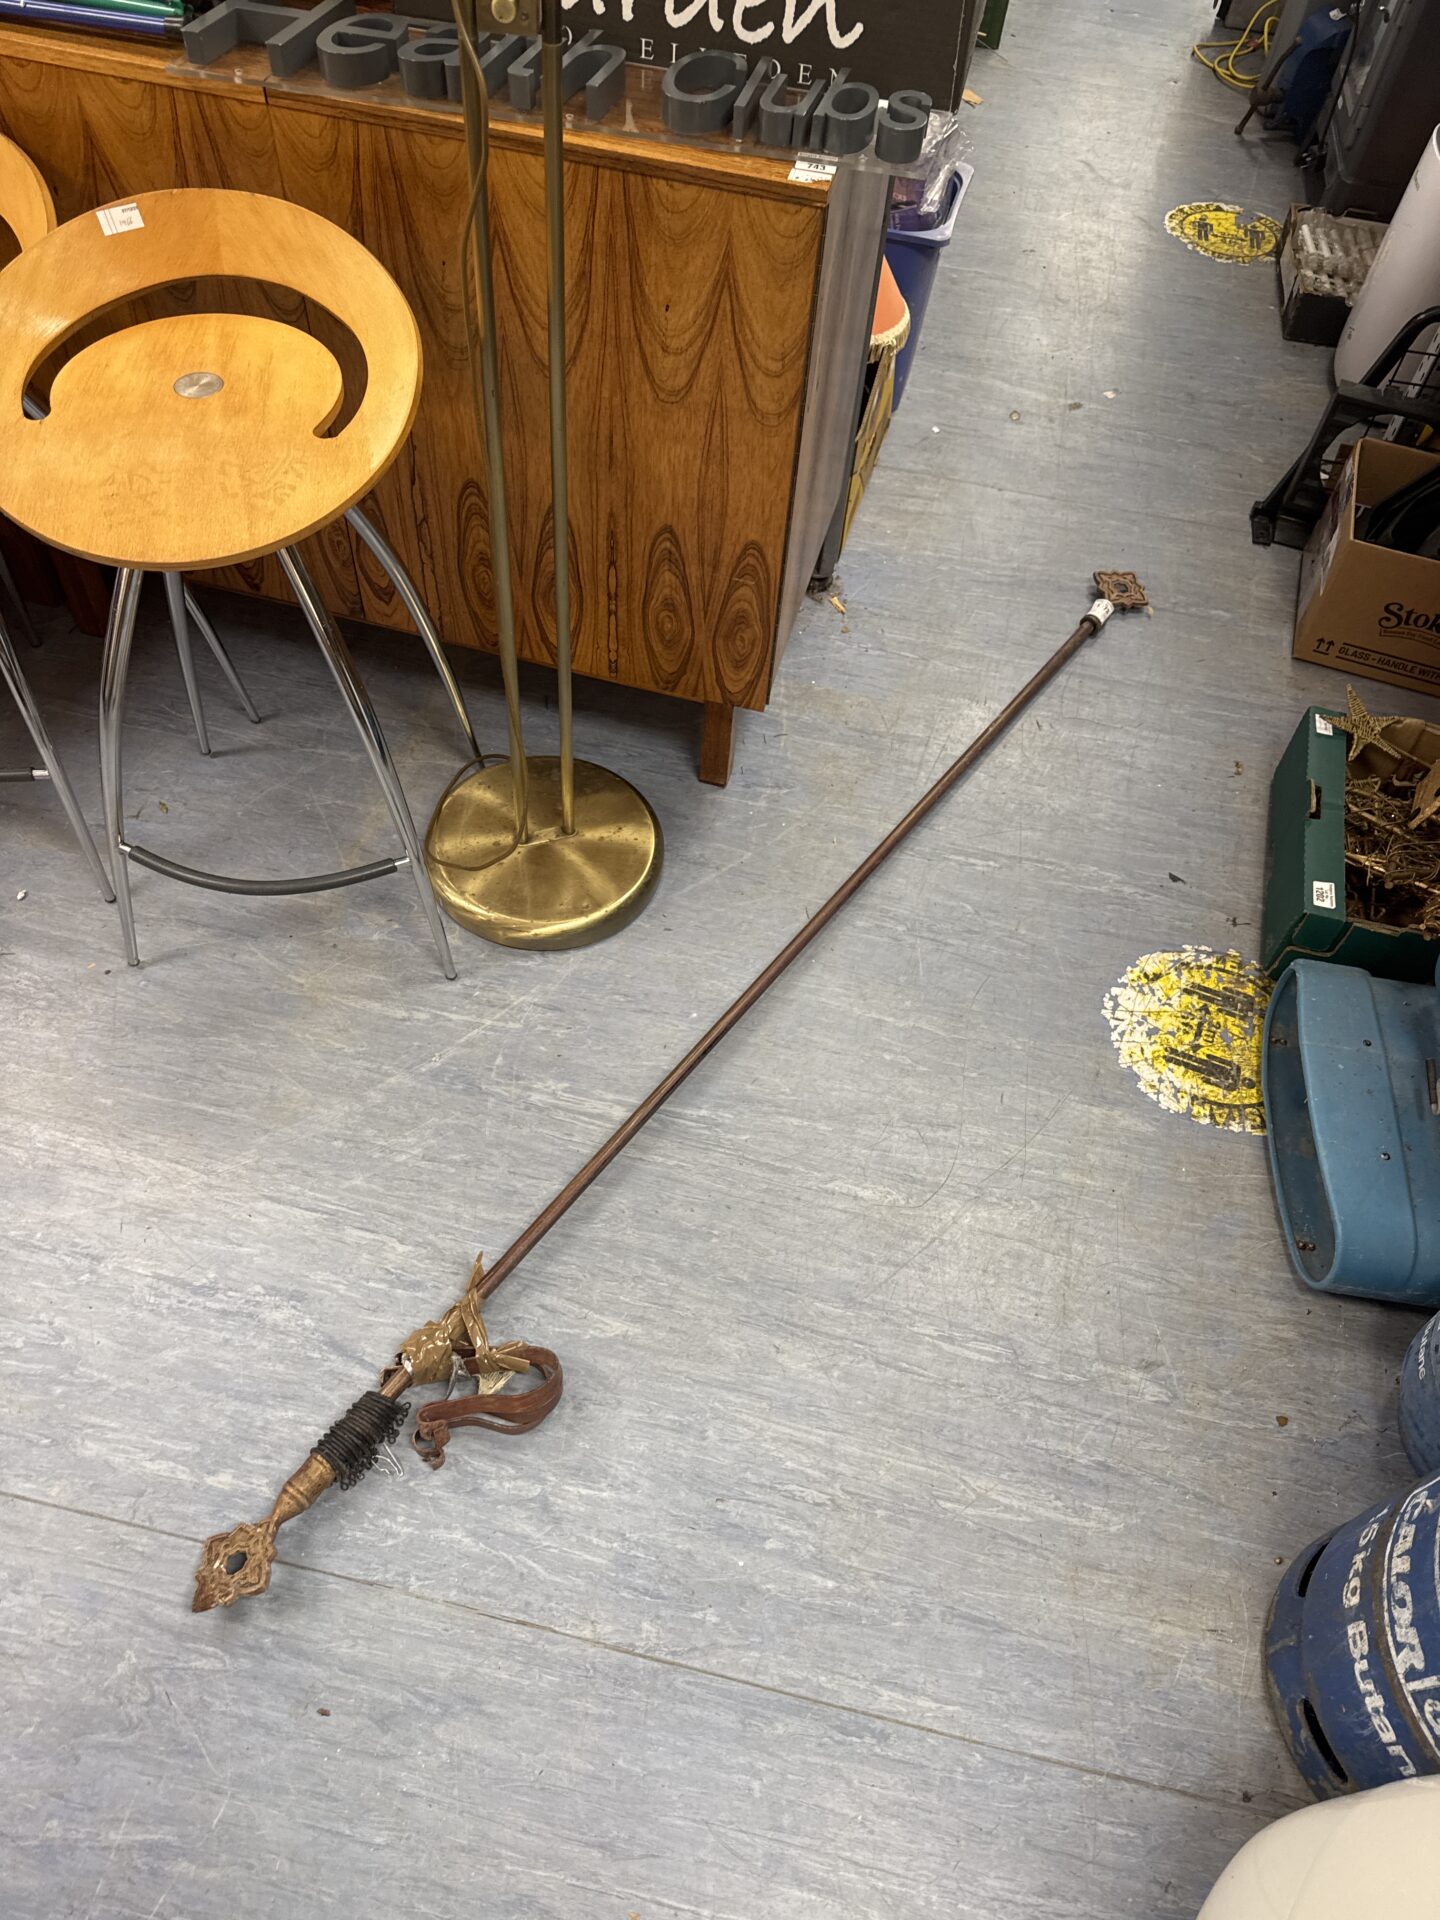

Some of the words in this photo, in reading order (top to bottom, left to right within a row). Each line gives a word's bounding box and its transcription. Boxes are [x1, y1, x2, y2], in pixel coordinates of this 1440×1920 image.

[662, 50, 933, 164] Clubs
[1338, 646, 1371, 662] GLASS
[1376, 657, 1417, 674] HANDLE
[1390, 1490, 1429, 1675] CALOR
